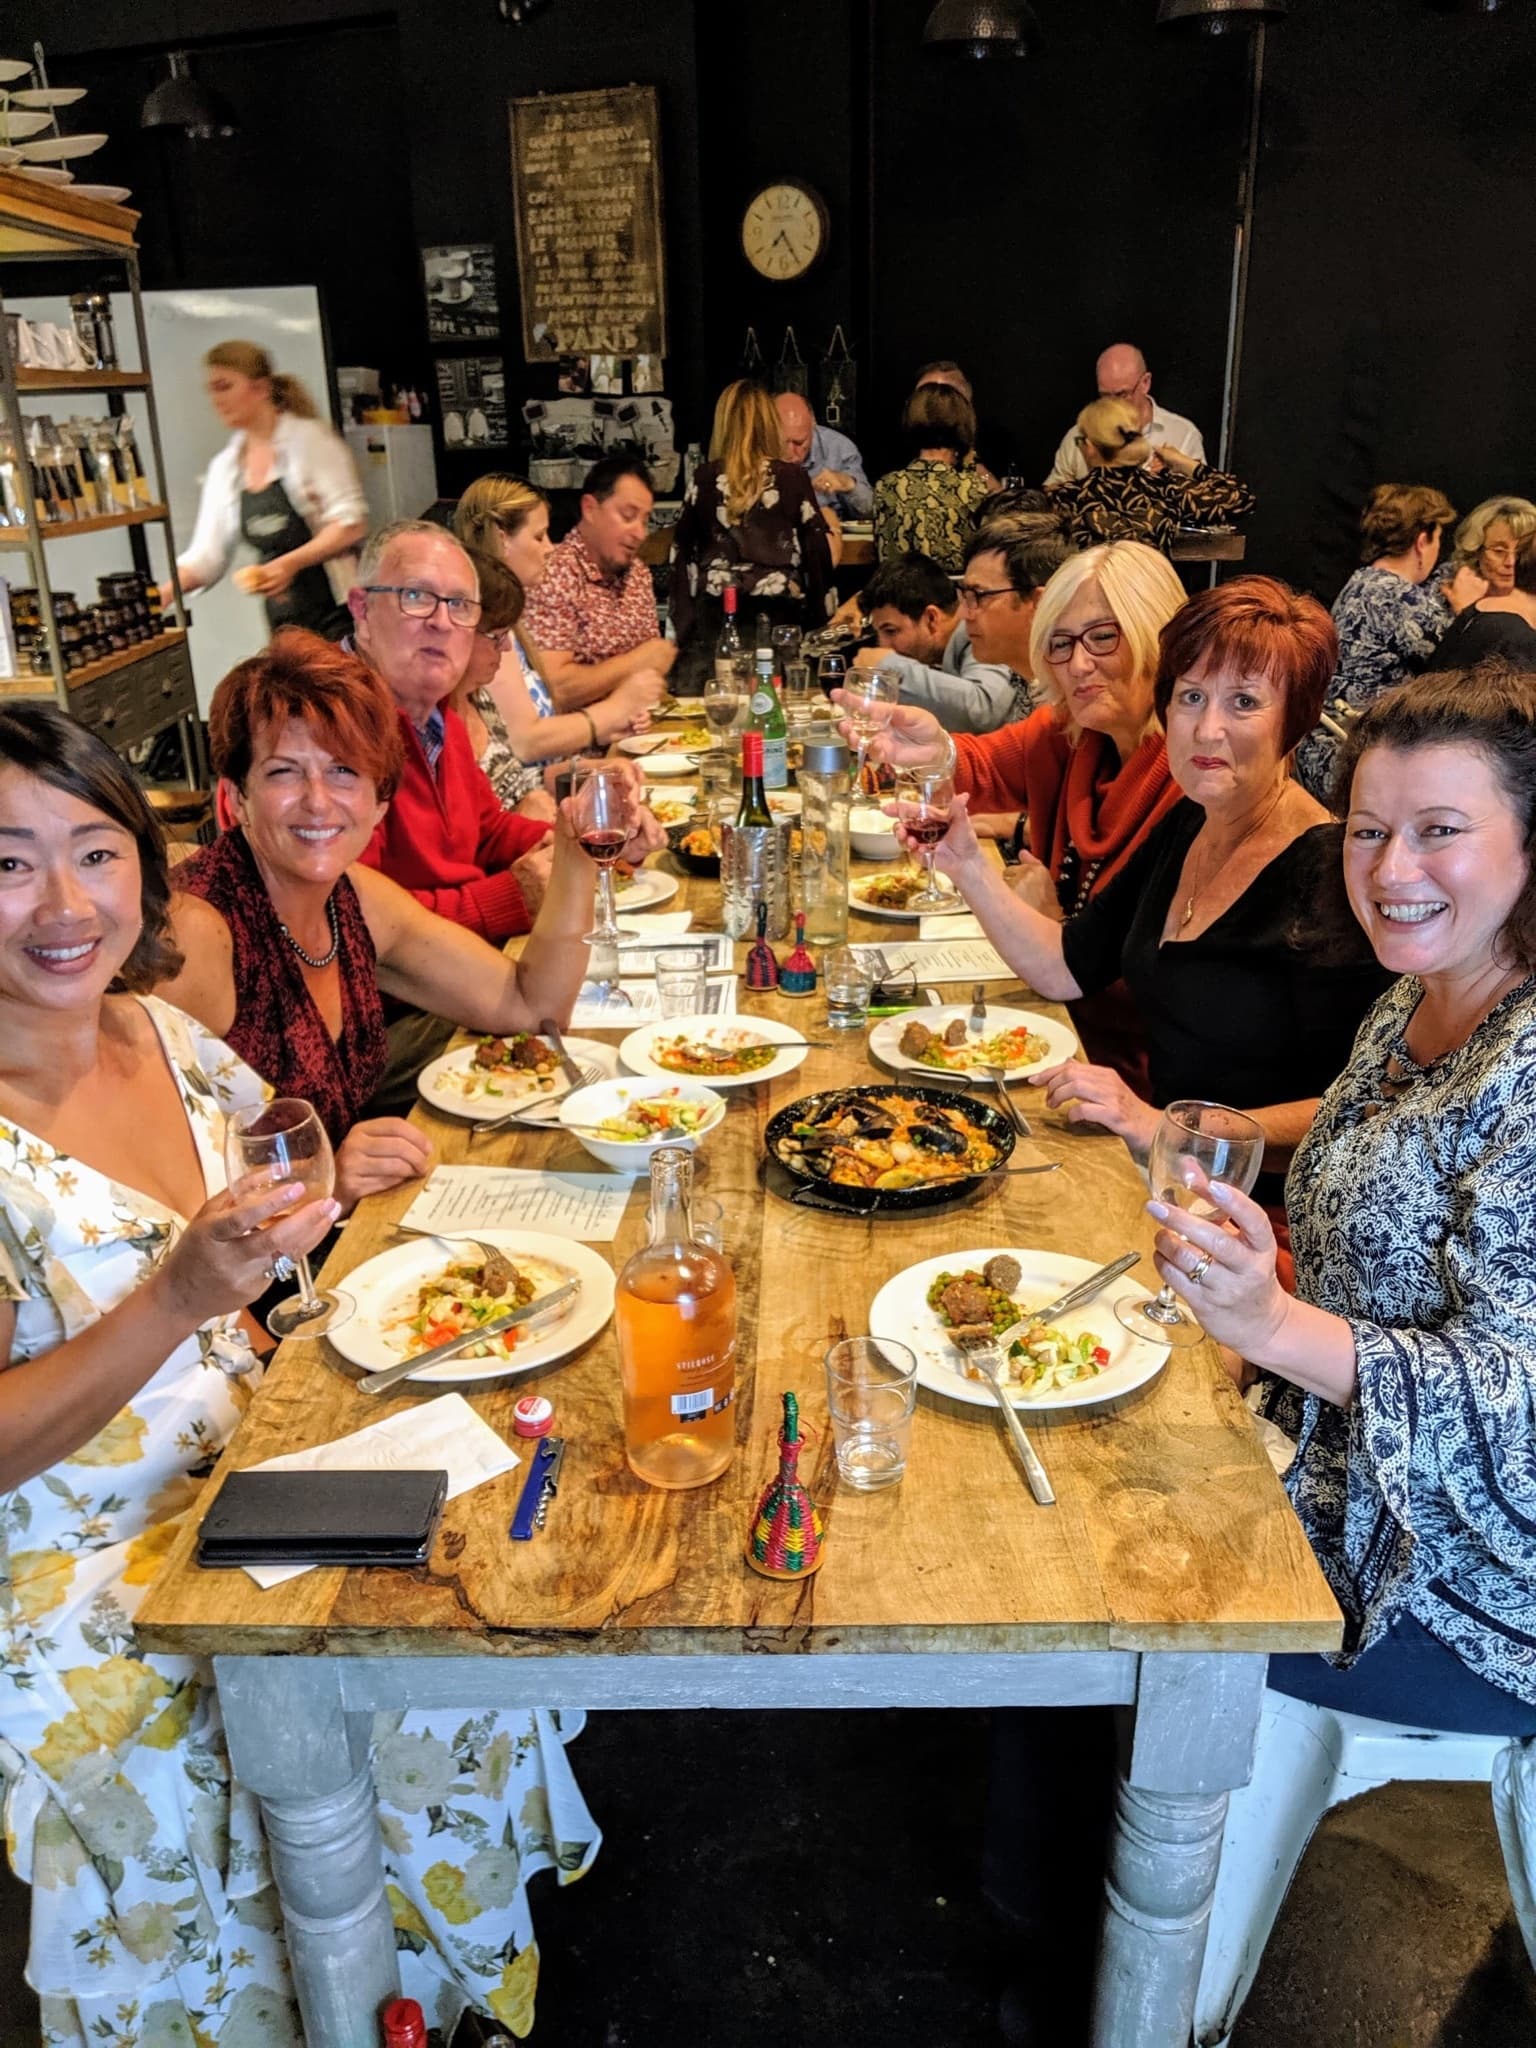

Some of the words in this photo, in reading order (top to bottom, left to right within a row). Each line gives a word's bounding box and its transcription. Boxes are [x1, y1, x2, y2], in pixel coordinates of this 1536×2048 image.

[777, 194, 790, 209] 12
[752, 226, 763, 240] 9
[807, 223, 815, 239] 3
[530, 237, 547, 253] LE
[555, 234, 619, 250] MARAIS
[779, 254, 790, 271] 6
[554, 324, 639, 353] PARIS
